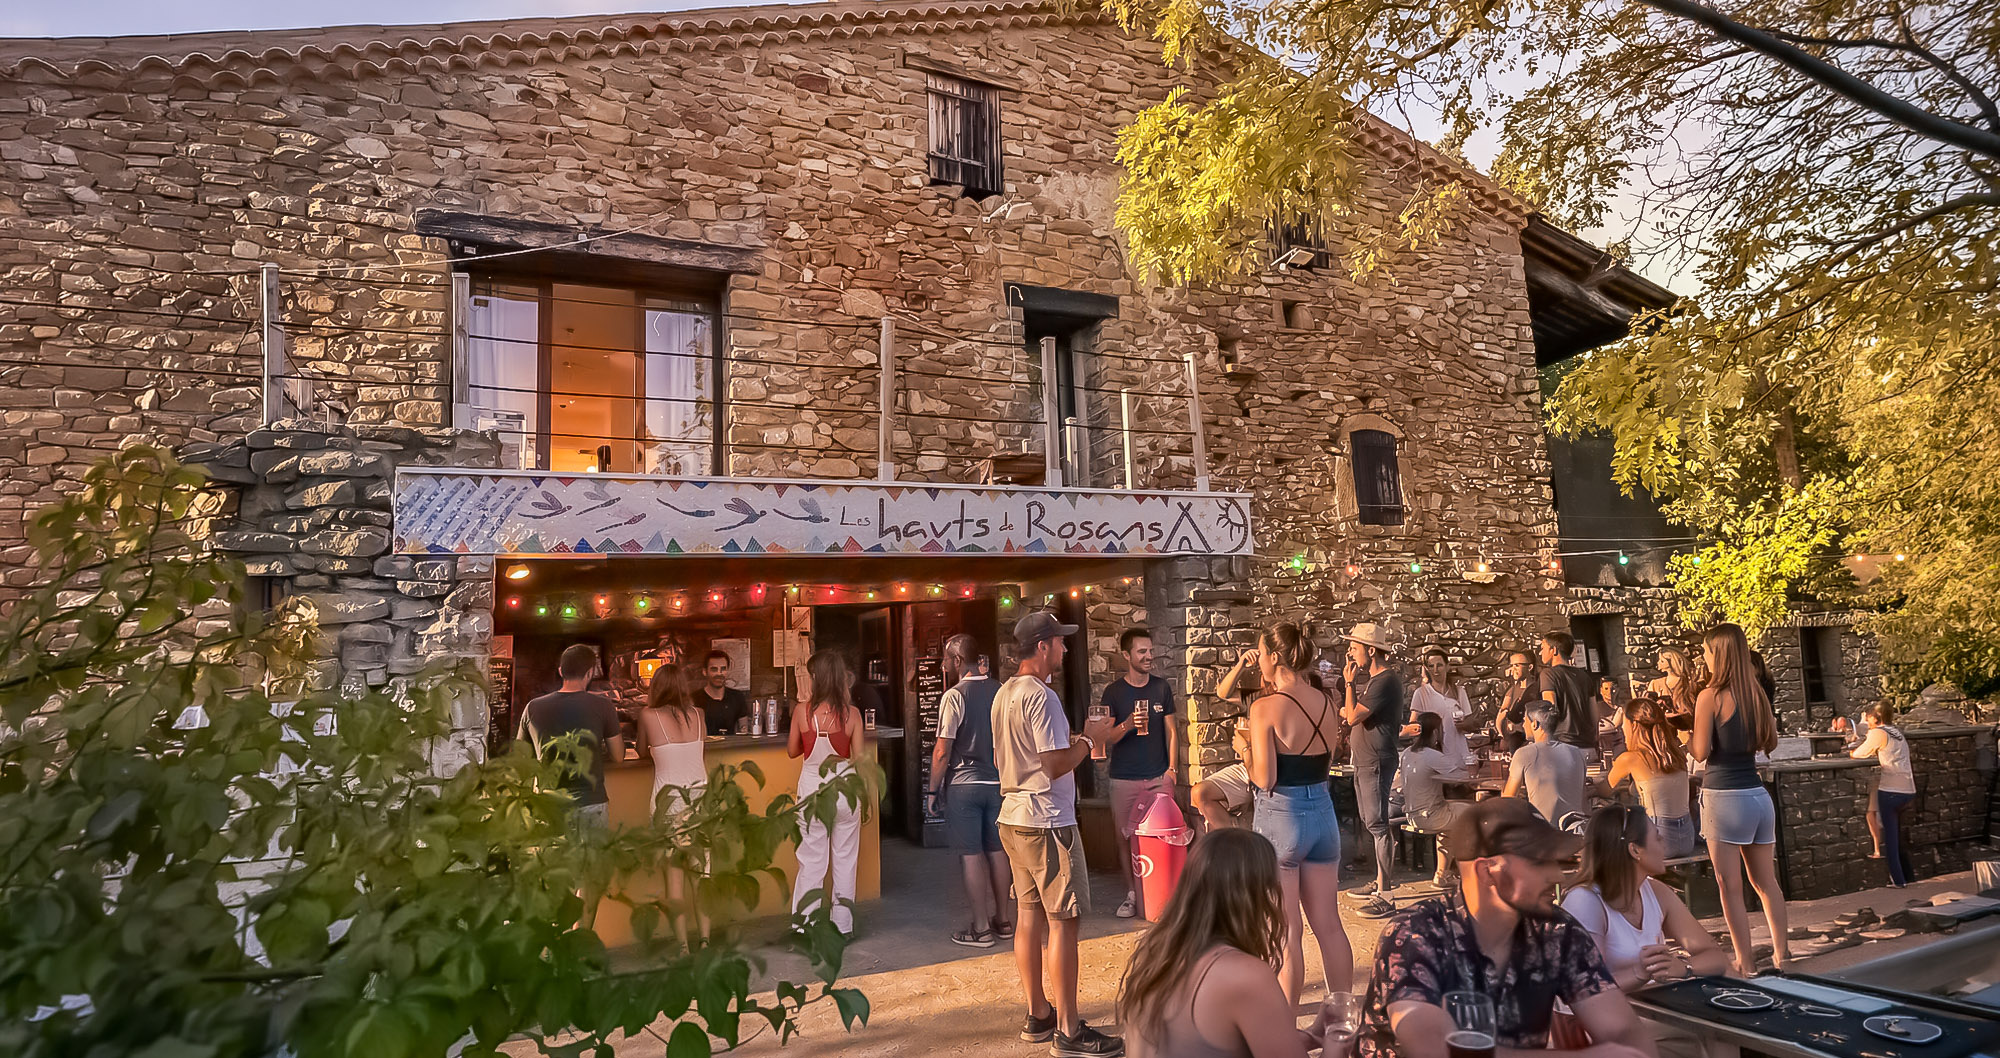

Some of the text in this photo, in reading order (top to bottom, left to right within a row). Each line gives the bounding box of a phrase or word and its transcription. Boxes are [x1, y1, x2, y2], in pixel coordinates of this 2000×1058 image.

[840, 506, 871, 526] Les
[999, 511, 1014, 531] de
[1026, 500, 1164, 542] Rosans
